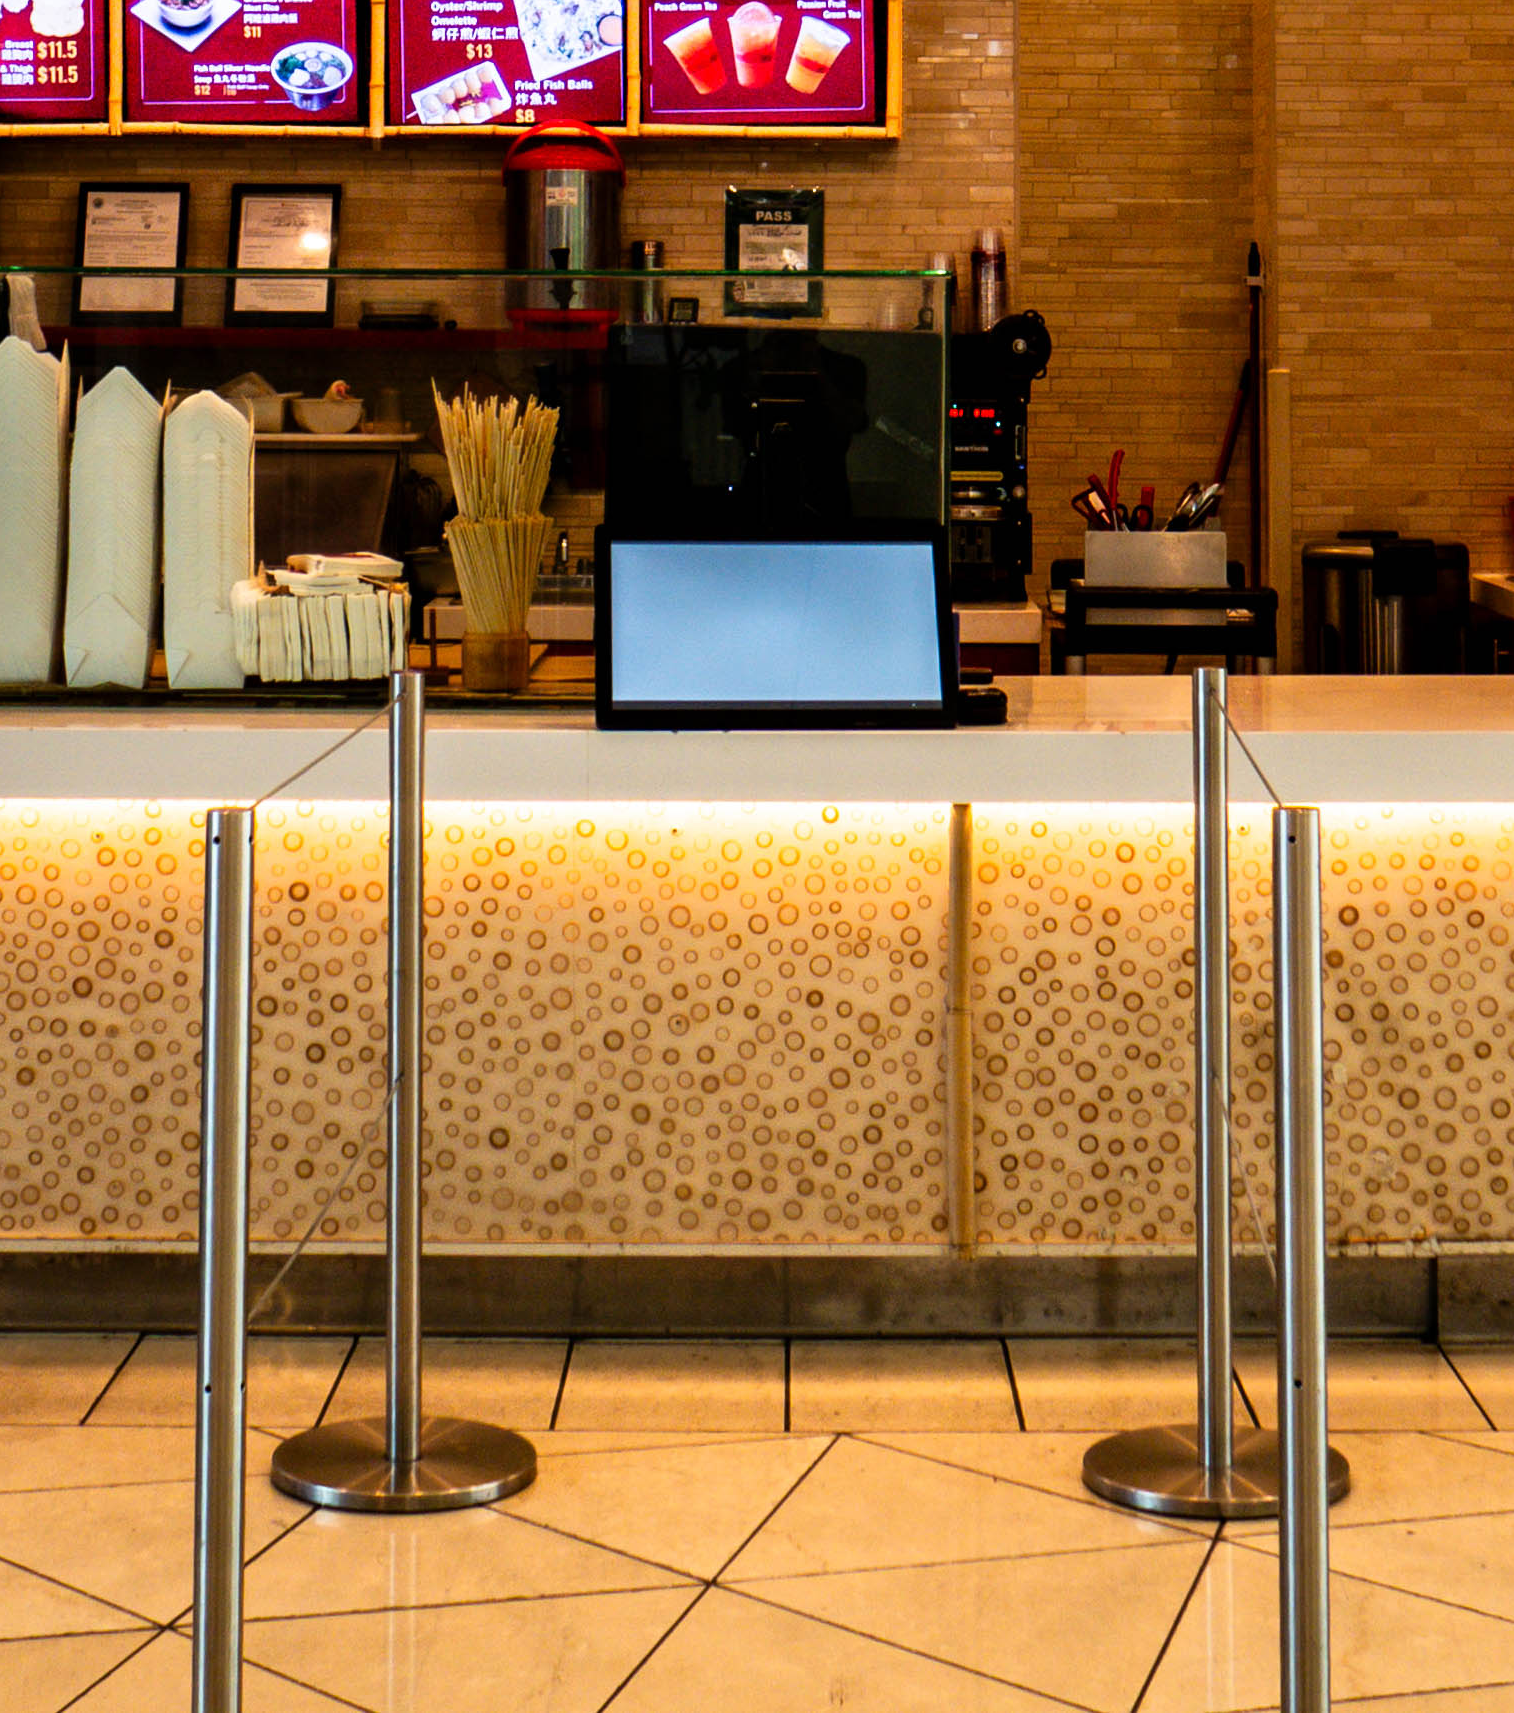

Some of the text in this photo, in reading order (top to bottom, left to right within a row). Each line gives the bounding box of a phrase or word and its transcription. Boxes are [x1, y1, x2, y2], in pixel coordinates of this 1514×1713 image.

[431, 16, 477, 26] Omelette
[244, 26, 261, 38] $11
[37, 41, 77, 59] $11.5
[466, 44, 493, 60] $13
[37, 65, 78, 84] $11.5
[515, 79, 593, 91] Fried Fish Balls
[515, 109, 535, 124] $8
[756, 211, 792, 222] PASS
